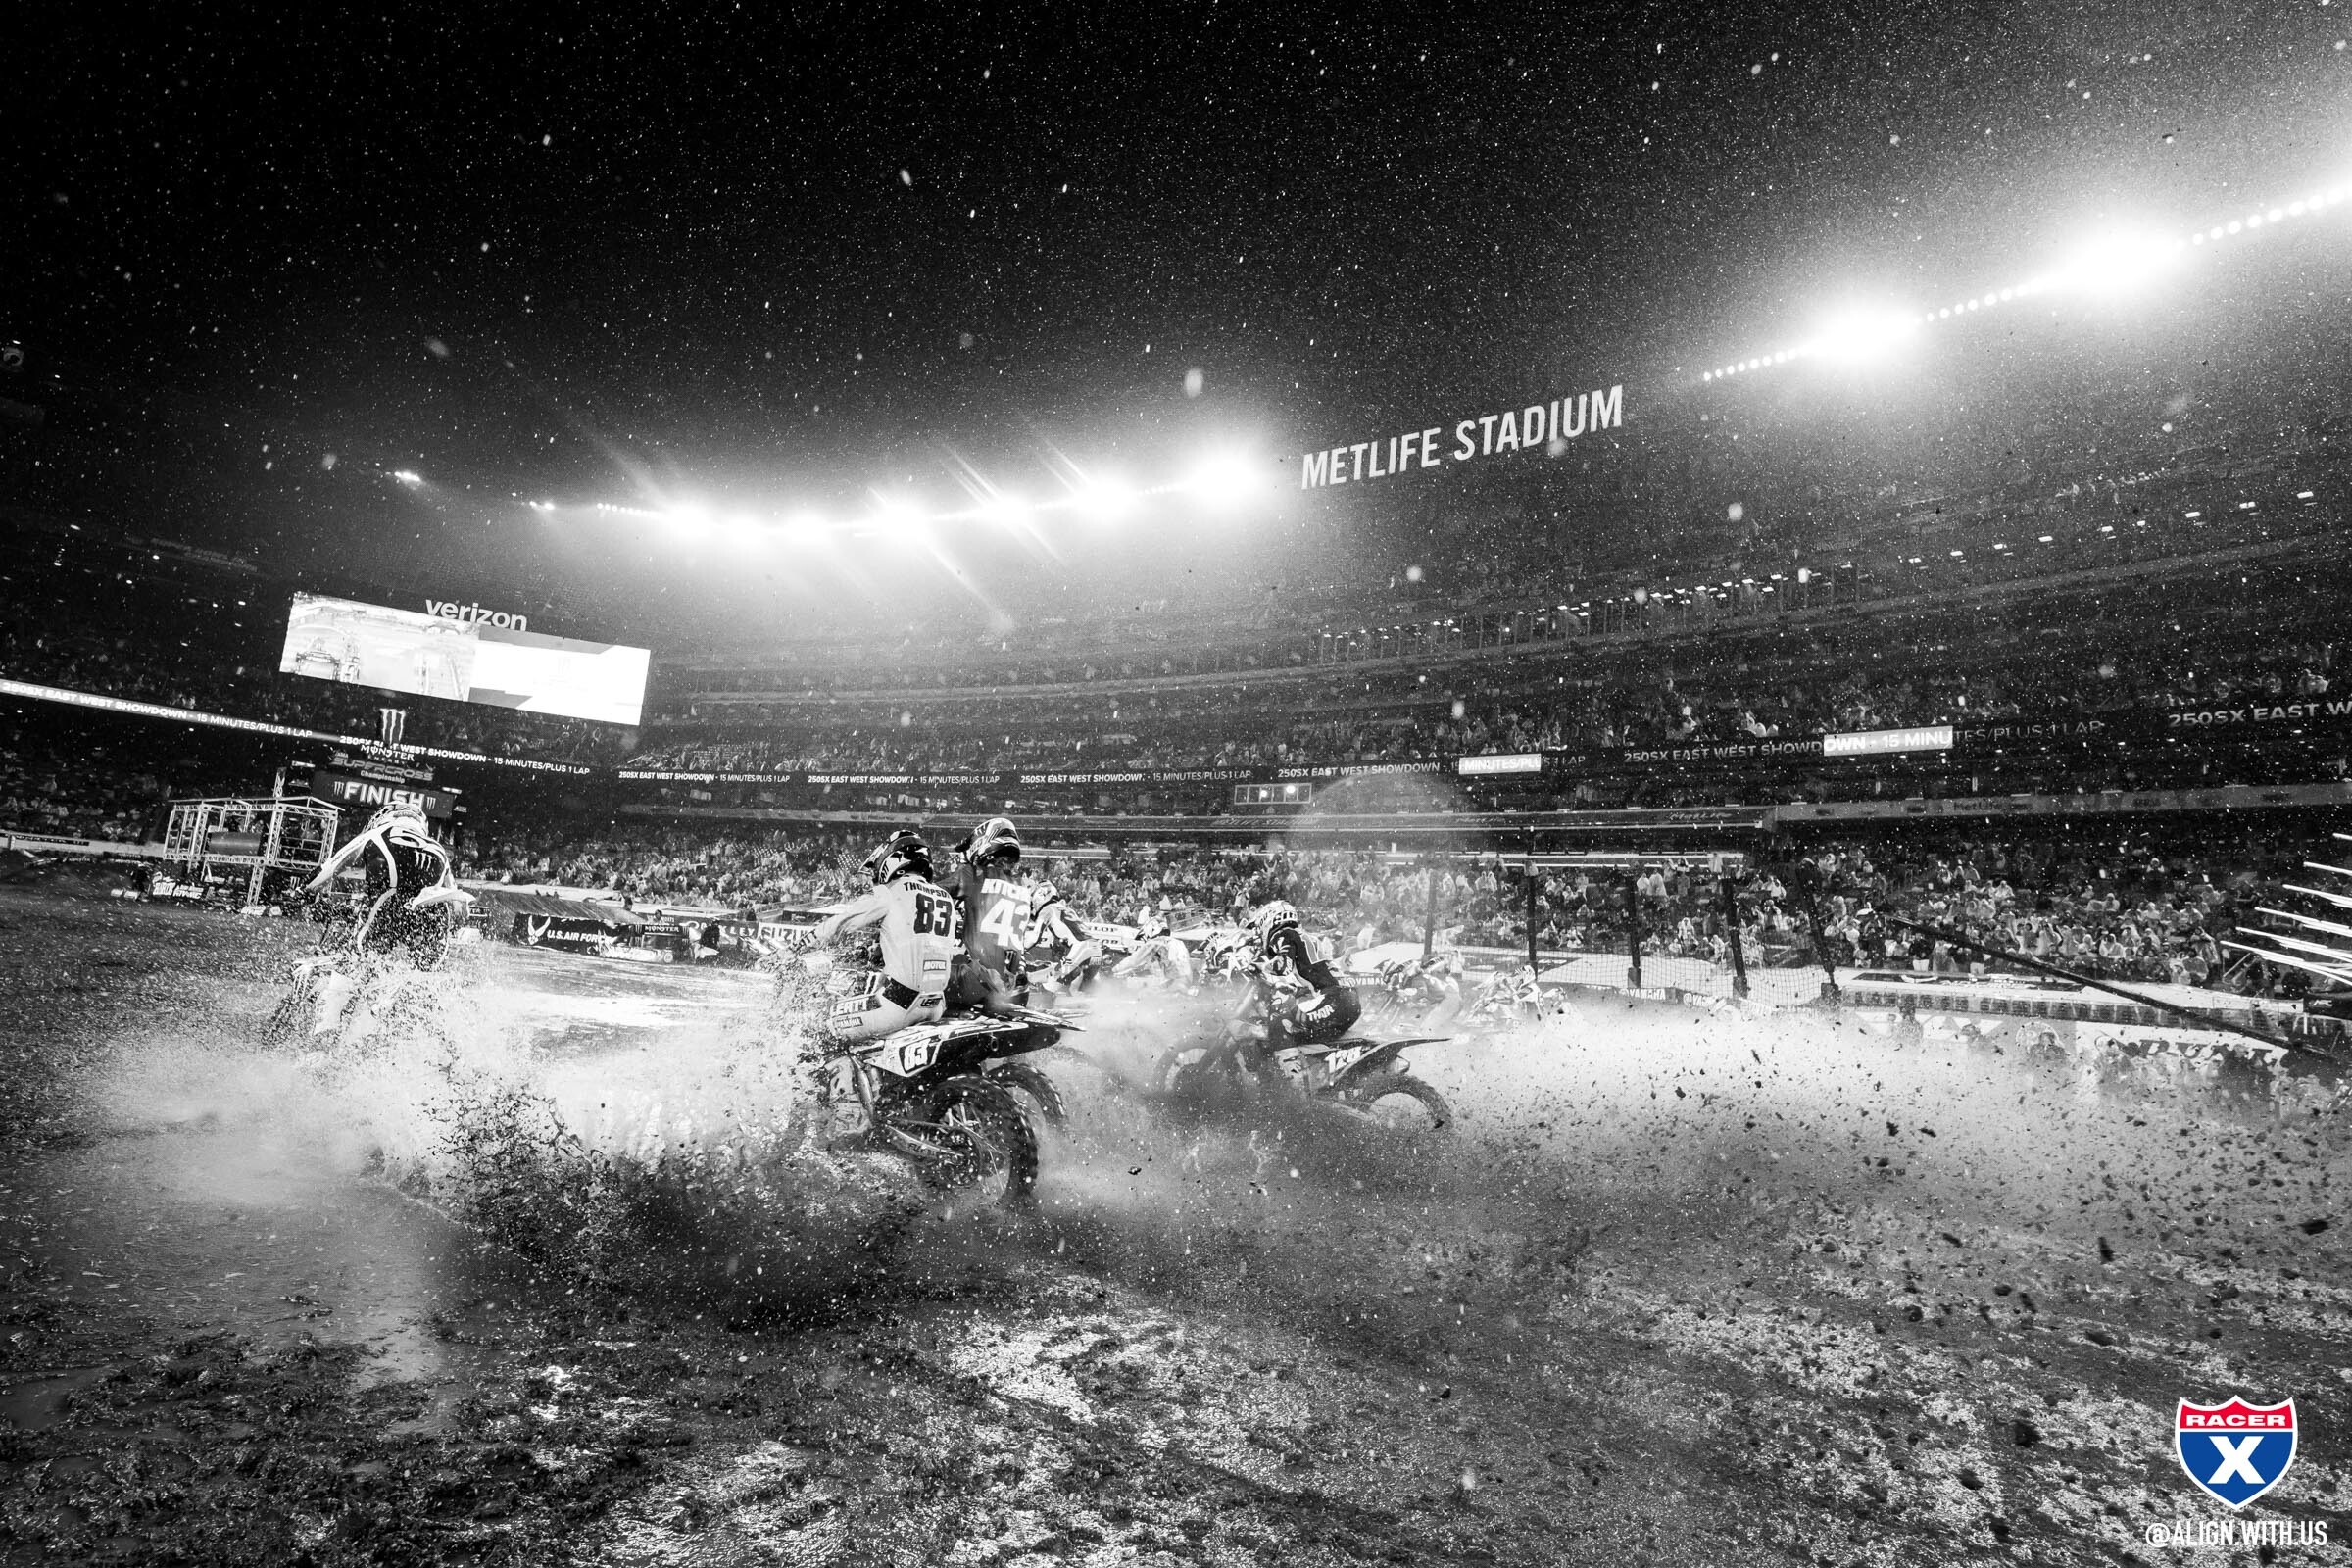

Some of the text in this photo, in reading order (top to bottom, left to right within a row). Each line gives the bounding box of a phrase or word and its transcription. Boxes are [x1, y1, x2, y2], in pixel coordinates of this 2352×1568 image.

[1301, 384, 1623, 490] METLIFE STADIUM
[425, 599, 528, 632] verizon
[3, 682, 43, 697] 250SX
[46, 688, 77, 702] EAST
[79, 693, 114, 708] WEST
[114, 700, 187, 719] SHOWDOWN
[197, 713, 208, 722] 15
[210, 715, 284, 734] MINUTES/PLUS
[293, 727, 312, 738] LAP
[2168, 709, 2245, 728] 250SX
[2254, 702, 2319, 722] EAST
[361, 745, 415, 761] MONSTER
[1624, 750, 1668, 763] 250SX
[1673, 748, 1709, 760] EAST
[1715, 745, 1756, 759] WEST
[1760, 736, 1866, 756] SHOWDOWN
[1882, 734, 1899, 749] 15
[2062, 719, 2101, 735] LAP
[330, 757, 434, 781] SUPERCROSS
[400, 744, 426, 754] WEST
[427, 746, 486, 762] SHOWDOWN
[494, 757, 503, 765] 15
[505, 758, 566, 773] MINUTES/PLUS
[573, 766, 590, 775] LAP
[1278, 766, 1309, 778] 250SX
[1311, 765, 1338, 777] EAST
[1340, 764, 1369, 776] WEST
[1371, 761, 1440, 775] SHOWDOWN
[361, 770, 405, 784] Championship
[639, 771, 656, 780] EAST
[657, 772, 674, 781] WEST
[808, 775, 830, 784] 250SX
[831, 775, 849, 784] EAST
[849, 775, 868, 784] WEST
[920, 775, 928, 784] 15
[928, 775, 980, 784] MINUTES/PLUS
[1021, 774, 1046, 784] 250SX
[1048, 774, 1068, 784] EAST
[1069, 773, 1091, 784] WEST
[1152, 772, 1162, 782] 15
[1163, 770, 1225, 782] MINUTES/PLUS
[344, 781, 425, 808] FINISH
[914, 893, 952, 937] 83
[980, 898, 1030, 951] 43
[547, 930, 564, 940] U.S.
[564, 931, 580, 941] AIR
[1307, 1004, 1335, 1022] THOR
[904, 1039, 930, 1069] 83
